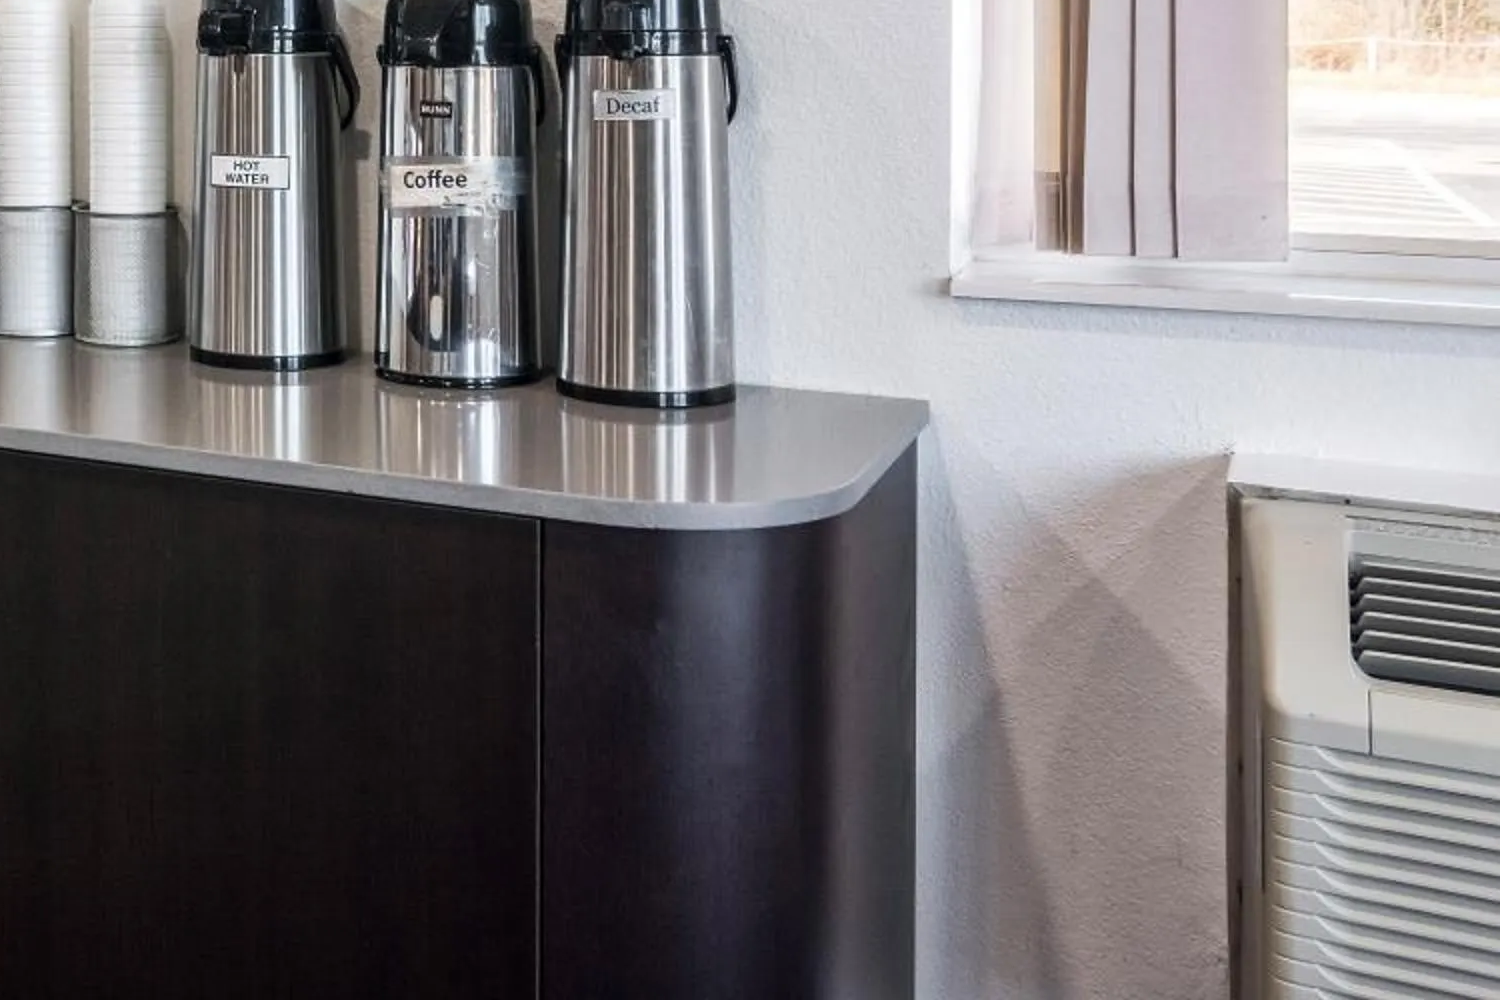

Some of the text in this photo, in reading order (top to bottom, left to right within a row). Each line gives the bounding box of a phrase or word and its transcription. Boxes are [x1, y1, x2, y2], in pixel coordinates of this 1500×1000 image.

[606, 95, 661, 115] Decaf
[232, 160, 261, 172] HOT
[225, 173, 270, 185] WATER
[403, 169, 468, 189] Coffee
